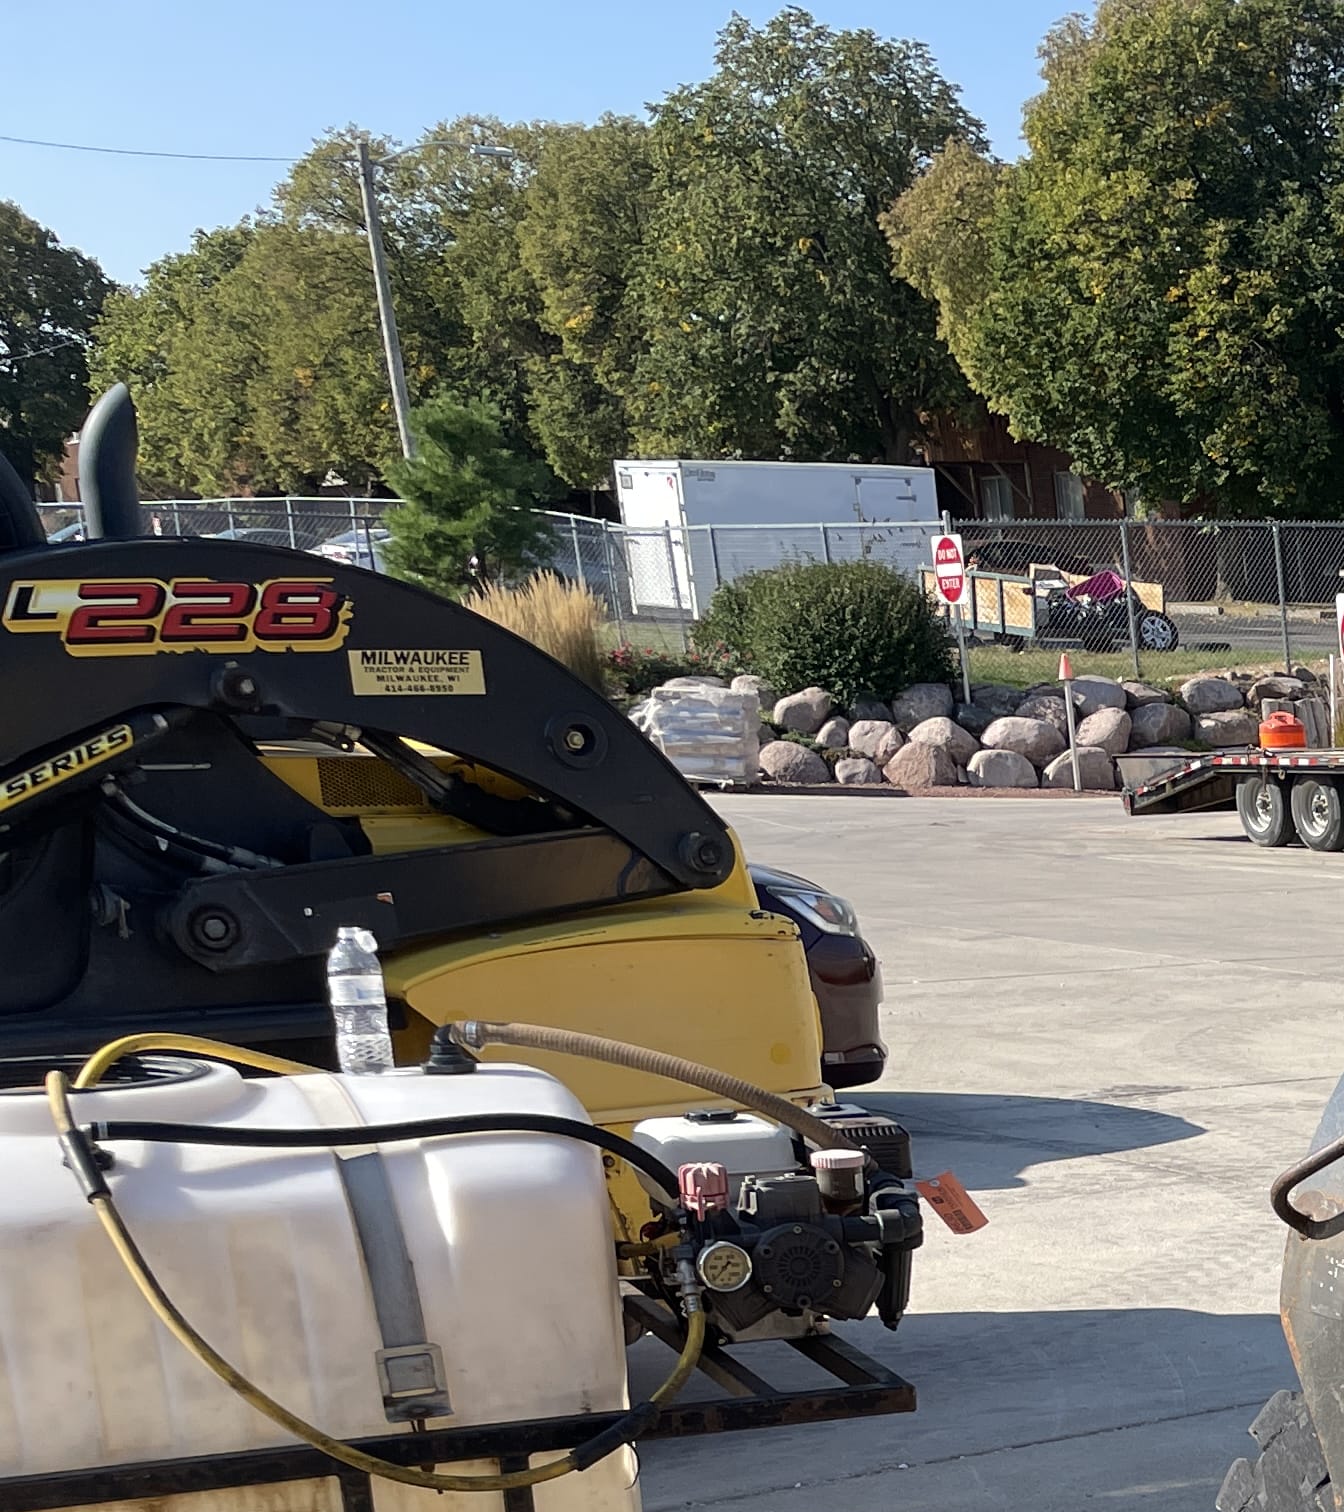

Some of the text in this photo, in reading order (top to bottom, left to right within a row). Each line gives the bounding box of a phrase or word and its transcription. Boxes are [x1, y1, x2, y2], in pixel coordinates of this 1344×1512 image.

[8, 581, 346, 646] L228
[361, 651, 470, 665] MILWAUKEE
[4, 725, 129, 801] SERIES
